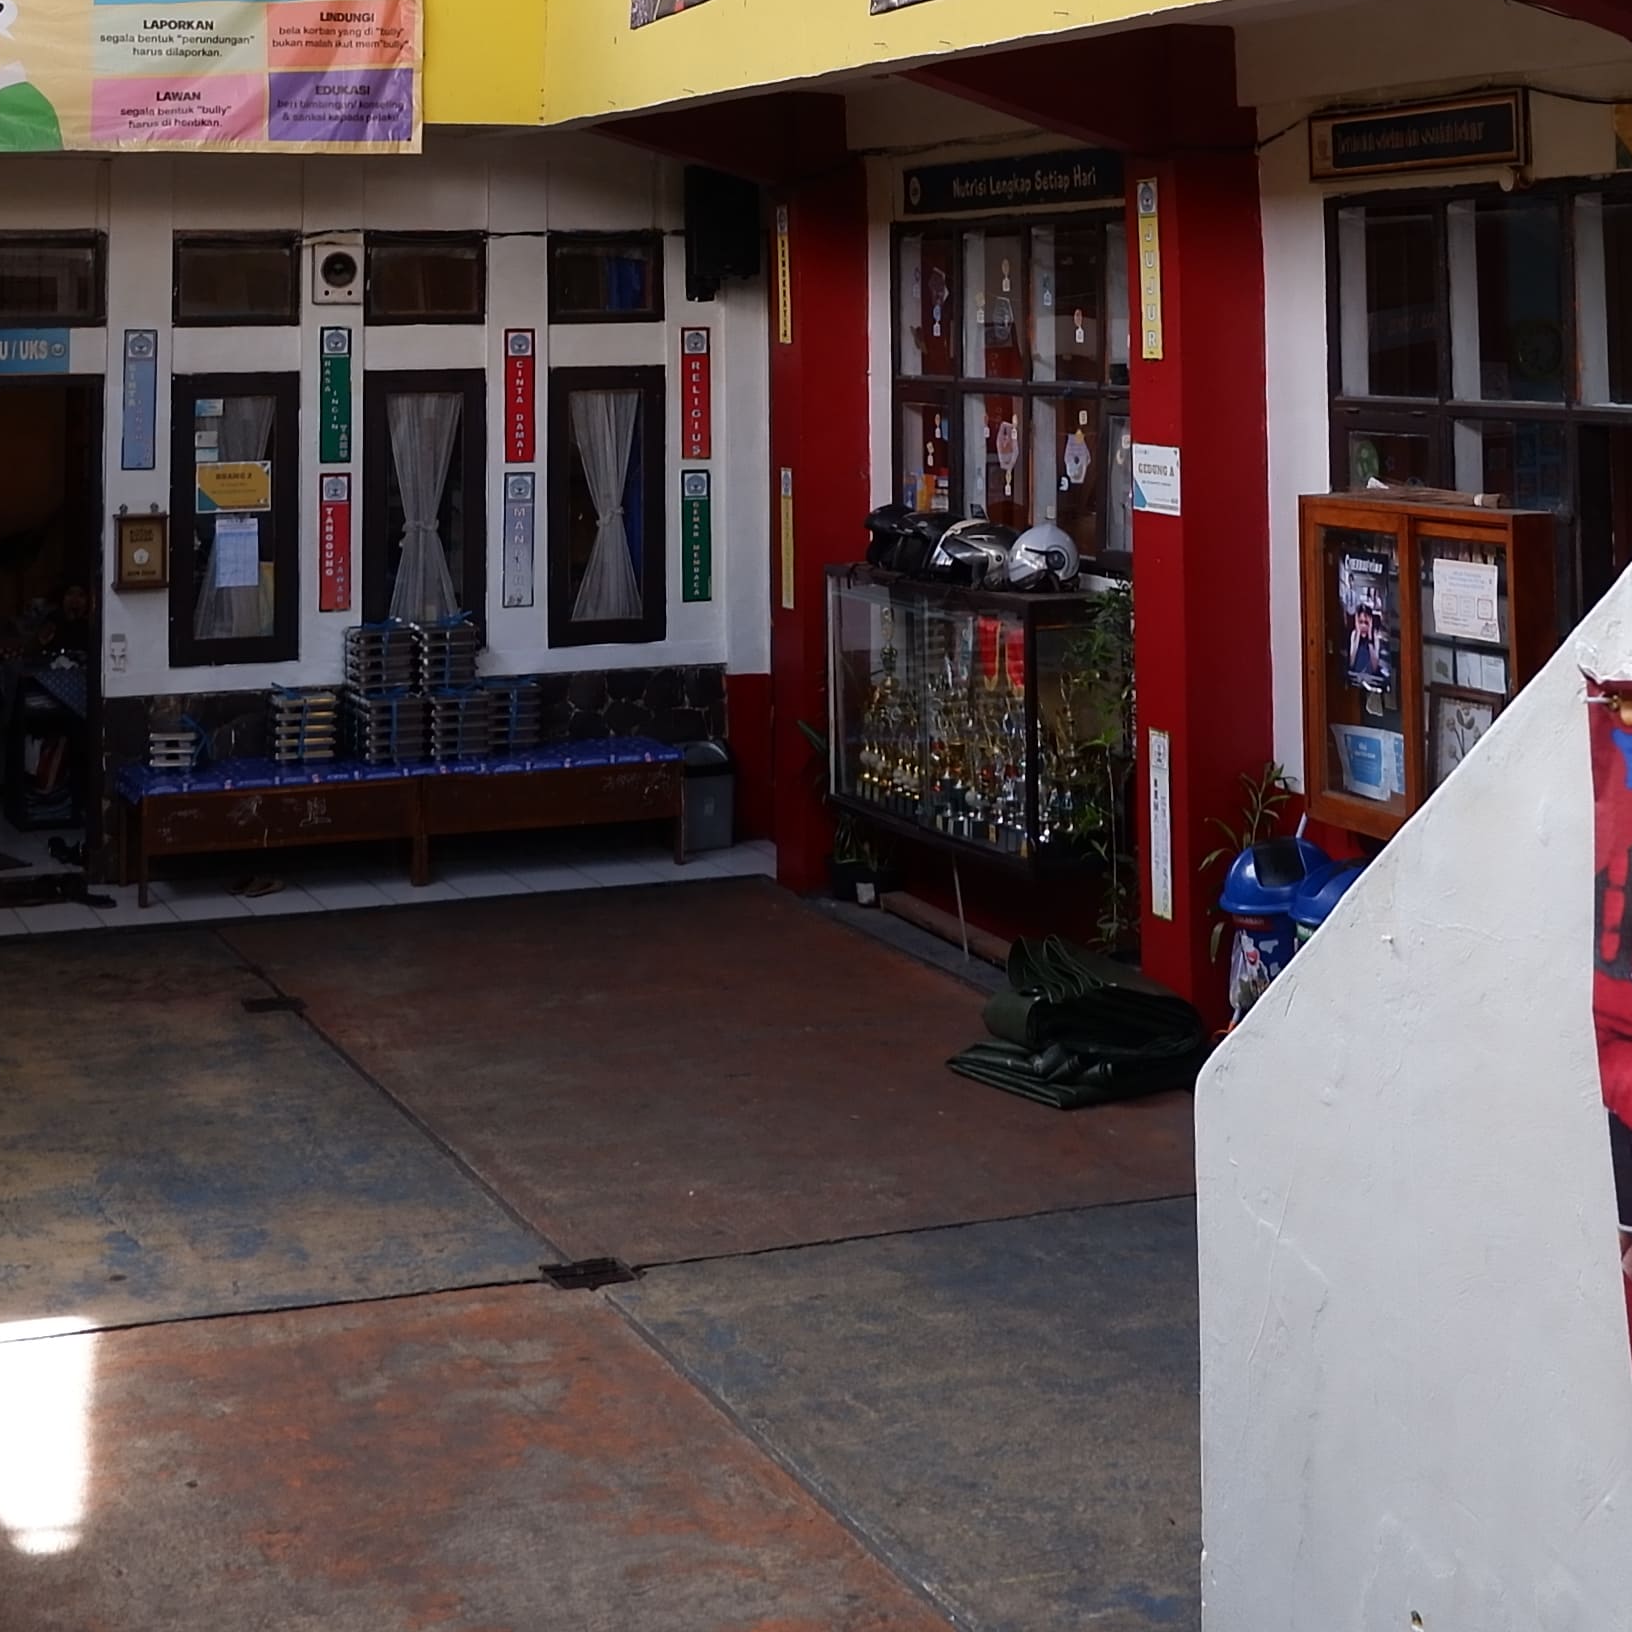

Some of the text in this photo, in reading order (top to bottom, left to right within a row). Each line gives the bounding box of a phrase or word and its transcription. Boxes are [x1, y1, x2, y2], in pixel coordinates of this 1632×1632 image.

[319, 12, 375, 23] LINDUNGI
[143, 19, 214, 31] LAPORKAN
[279, 25, 301, 35] bela
[303, 26, 336, 36] korban
[99, 33, 135, 45] segala
[137, 33, 174, 44] bentuk
[272, 39, 302, 48] bukan
[132, 47, 223, 59] harus dilaporkan.
[155, 91, 201, 102] LAWAN
[315, 85, 370, 96] EDUKASI
[120, 106, 155, 117] segala
[157, 105, 195, 116] bentuk
[128, 118, 159, 129] harus
[161, 118, 172, 128] di
[952, 163, 1097, 200] Nutrisi Lengkap Setiap Hari
[1143, 224, 1157, 348] JUJUR
[11, 339, 16, 361] /
[19, 339, 48, 361] UKS
[515, 360, 525, 457] CINTA DAMAI
[691, 361, 701, 456] RELIGIUS
